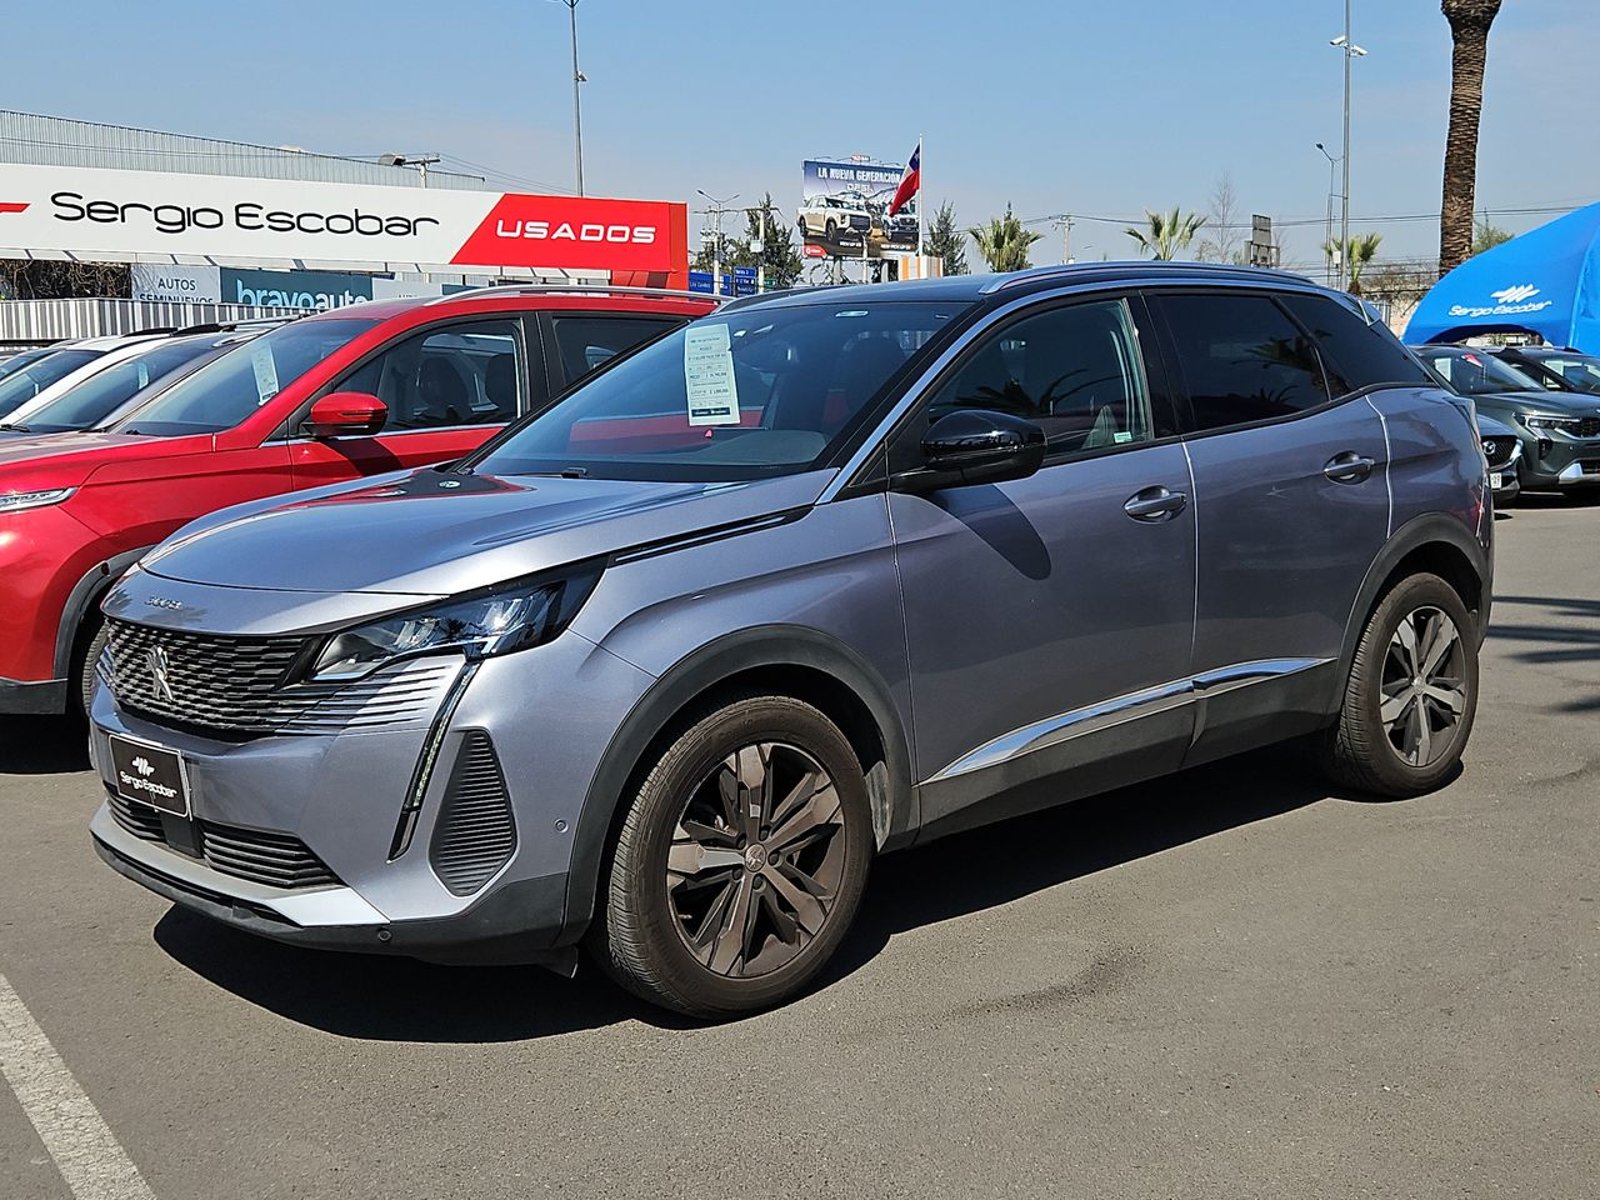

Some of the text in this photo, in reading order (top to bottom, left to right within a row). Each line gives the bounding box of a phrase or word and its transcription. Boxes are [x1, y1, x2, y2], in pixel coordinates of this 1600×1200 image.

[817, 167, 828, 179] LA
[829, 168, 855, 181] NUEVA
[50, 191, 440, 236] Sergio Escobar
[496, 219, 656, 244] USADOS
[158, 278, 196, 291] AUTOS
[1492, 300, 1553, 315] Escobar
[142, 778, 178, 798] Escobar
